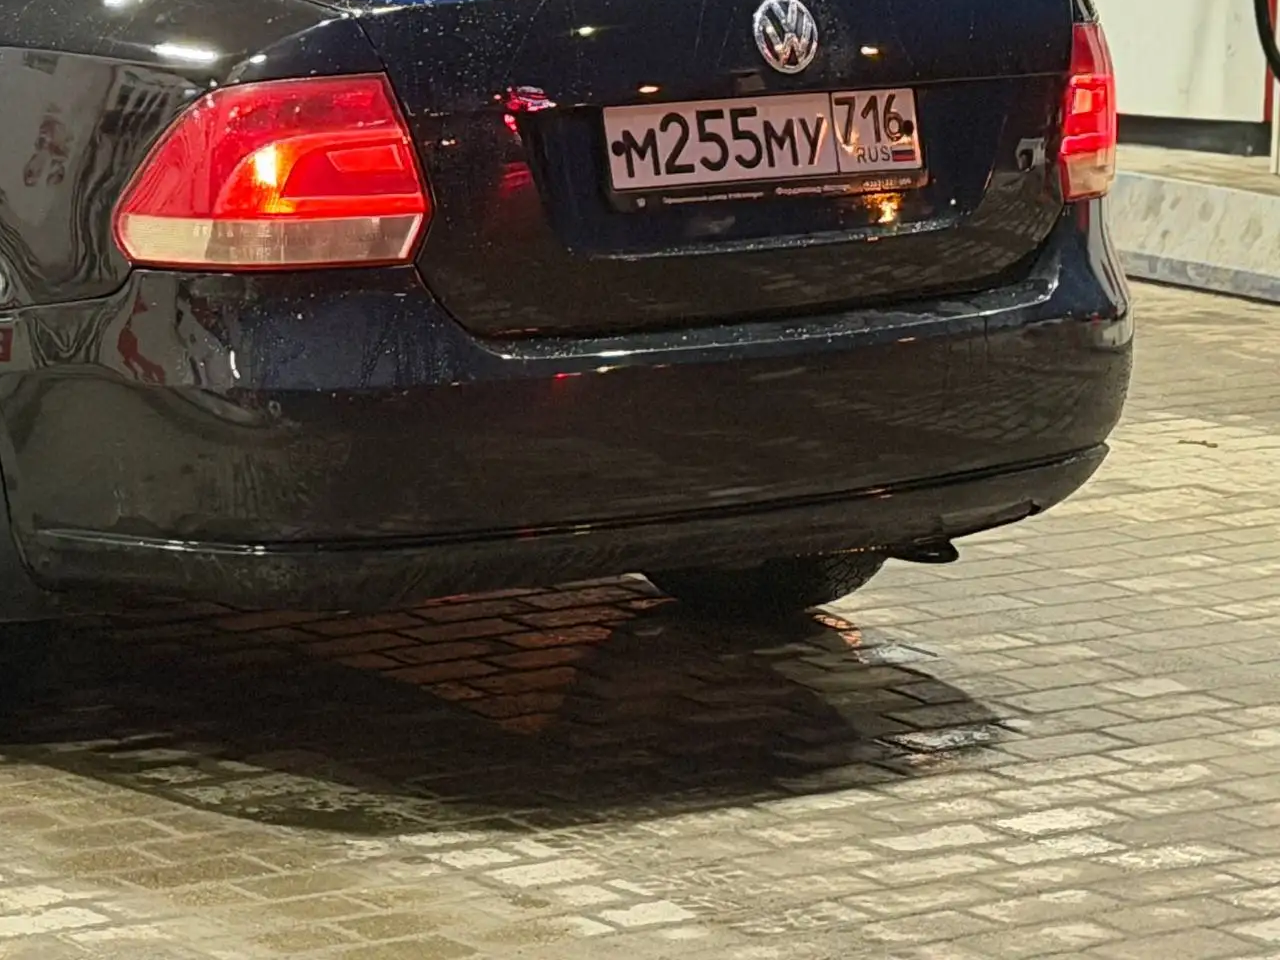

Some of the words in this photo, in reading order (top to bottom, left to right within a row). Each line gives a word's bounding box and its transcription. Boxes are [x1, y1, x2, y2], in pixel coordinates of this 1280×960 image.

[622, 106, 827, 179] М255МУ
[834, 93, 904, 146] 716
[856, 145, 891, 164] RUS
